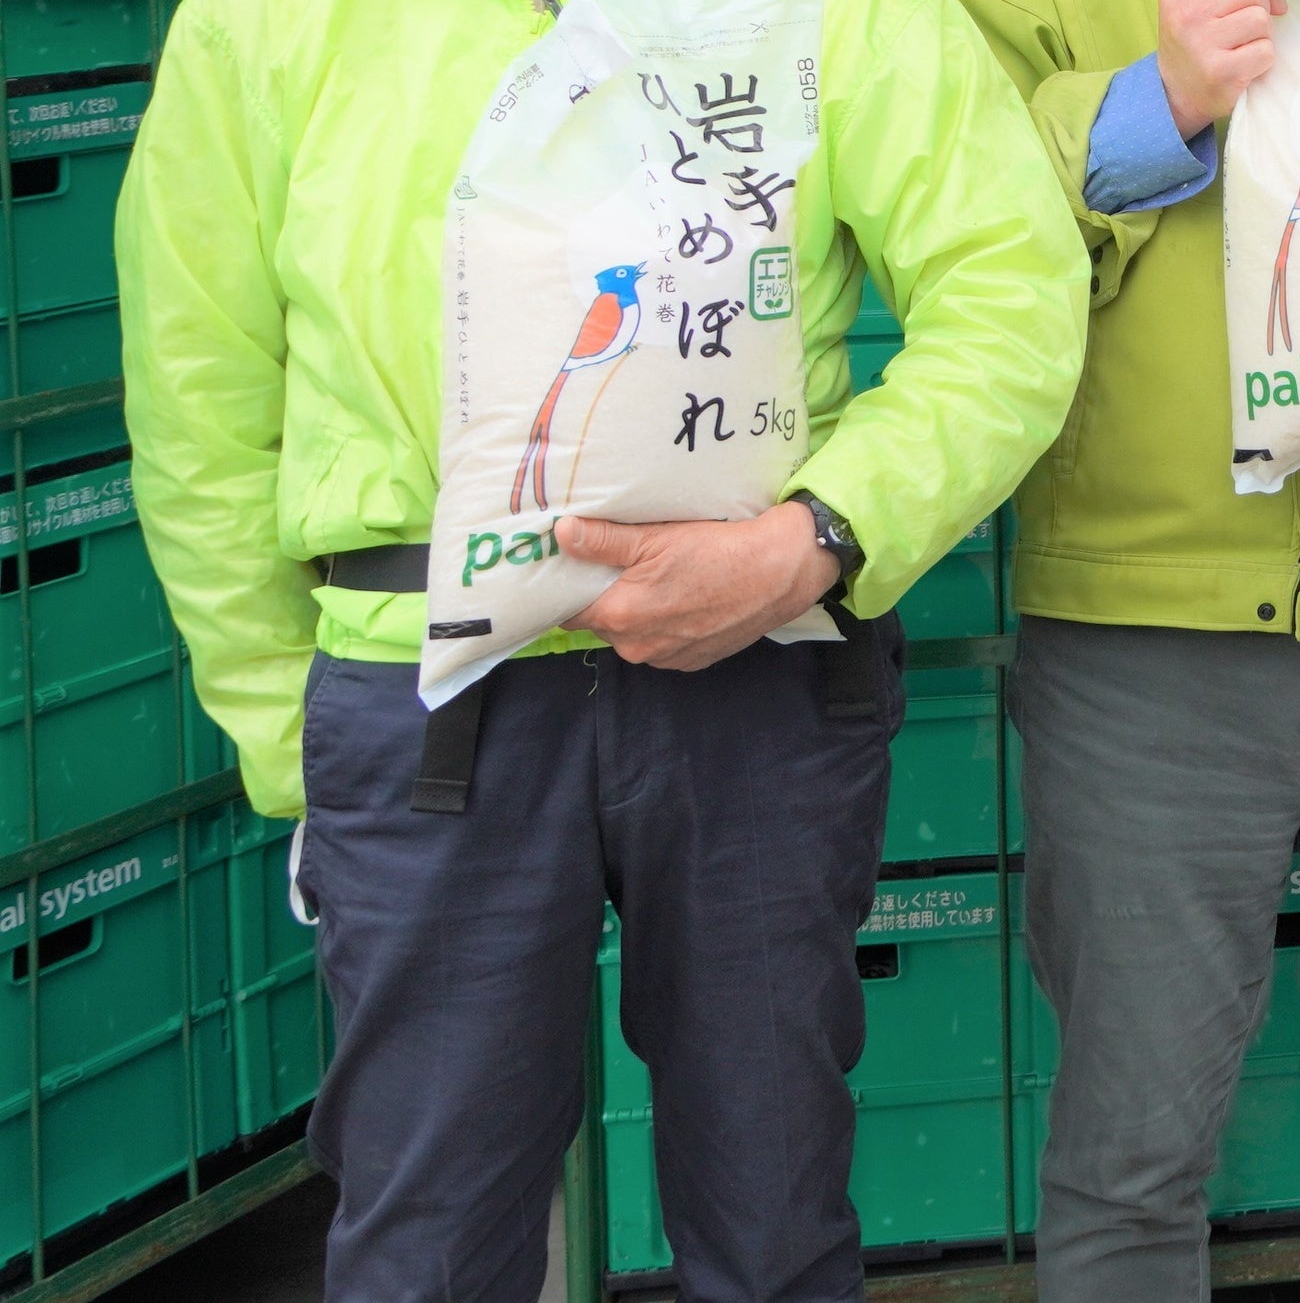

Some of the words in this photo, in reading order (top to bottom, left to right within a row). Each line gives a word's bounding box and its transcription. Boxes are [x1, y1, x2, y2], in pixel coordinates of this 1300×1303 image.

[796, 57, 819, 101] 058
[685, 72, 797, 233] 岩手
[636, 71, 746, 453] ひとめぼれ
[749, 397, 797, 440] 5kg
[39, 857, 142, 920] system
